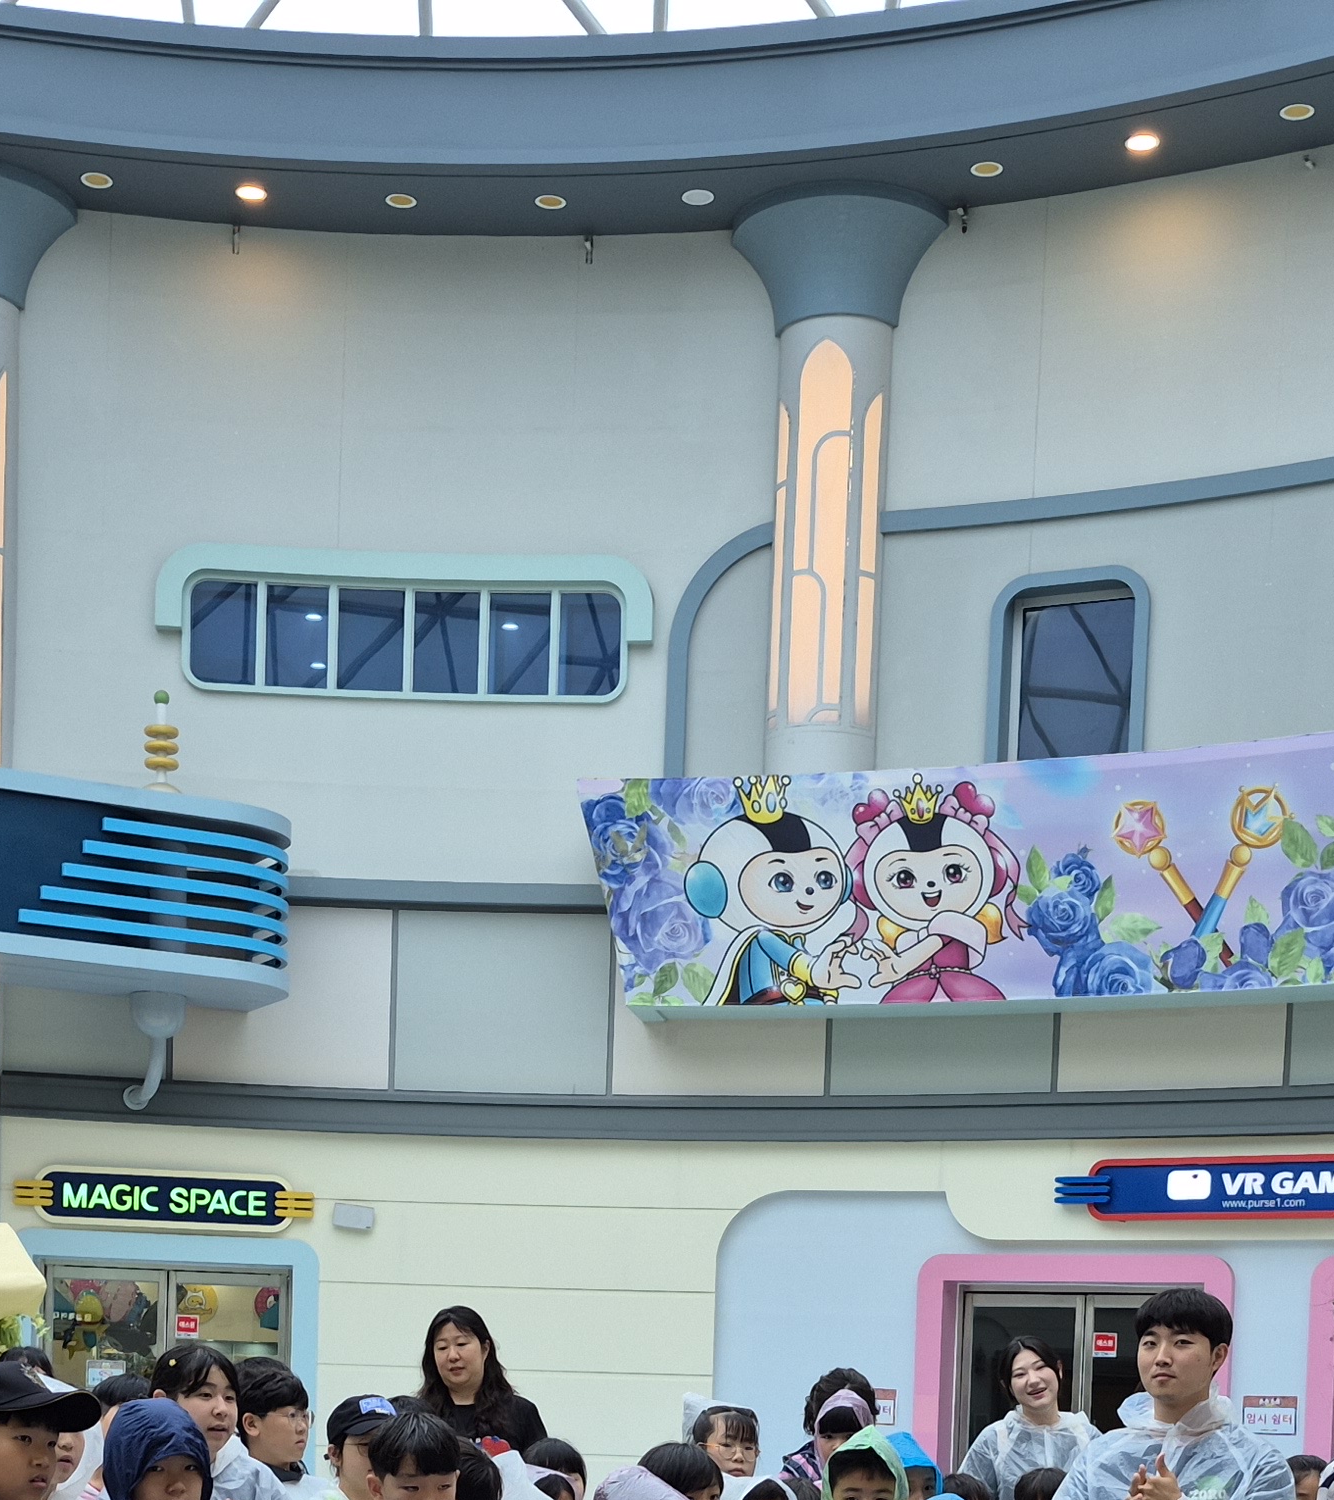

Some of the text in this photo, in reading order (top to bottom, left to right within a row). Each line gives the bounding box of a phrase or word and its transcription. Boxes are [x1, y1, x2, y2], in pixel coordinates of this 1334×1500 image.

[1221, 1172, 1265, 1195] VR
[62, 1181, 267, 1217] MAGIC SPACE
[1221, 1196, 1306, 1210] www.purse1.com
[1246, 1412, 1293, 1425] 임시 쉼터
